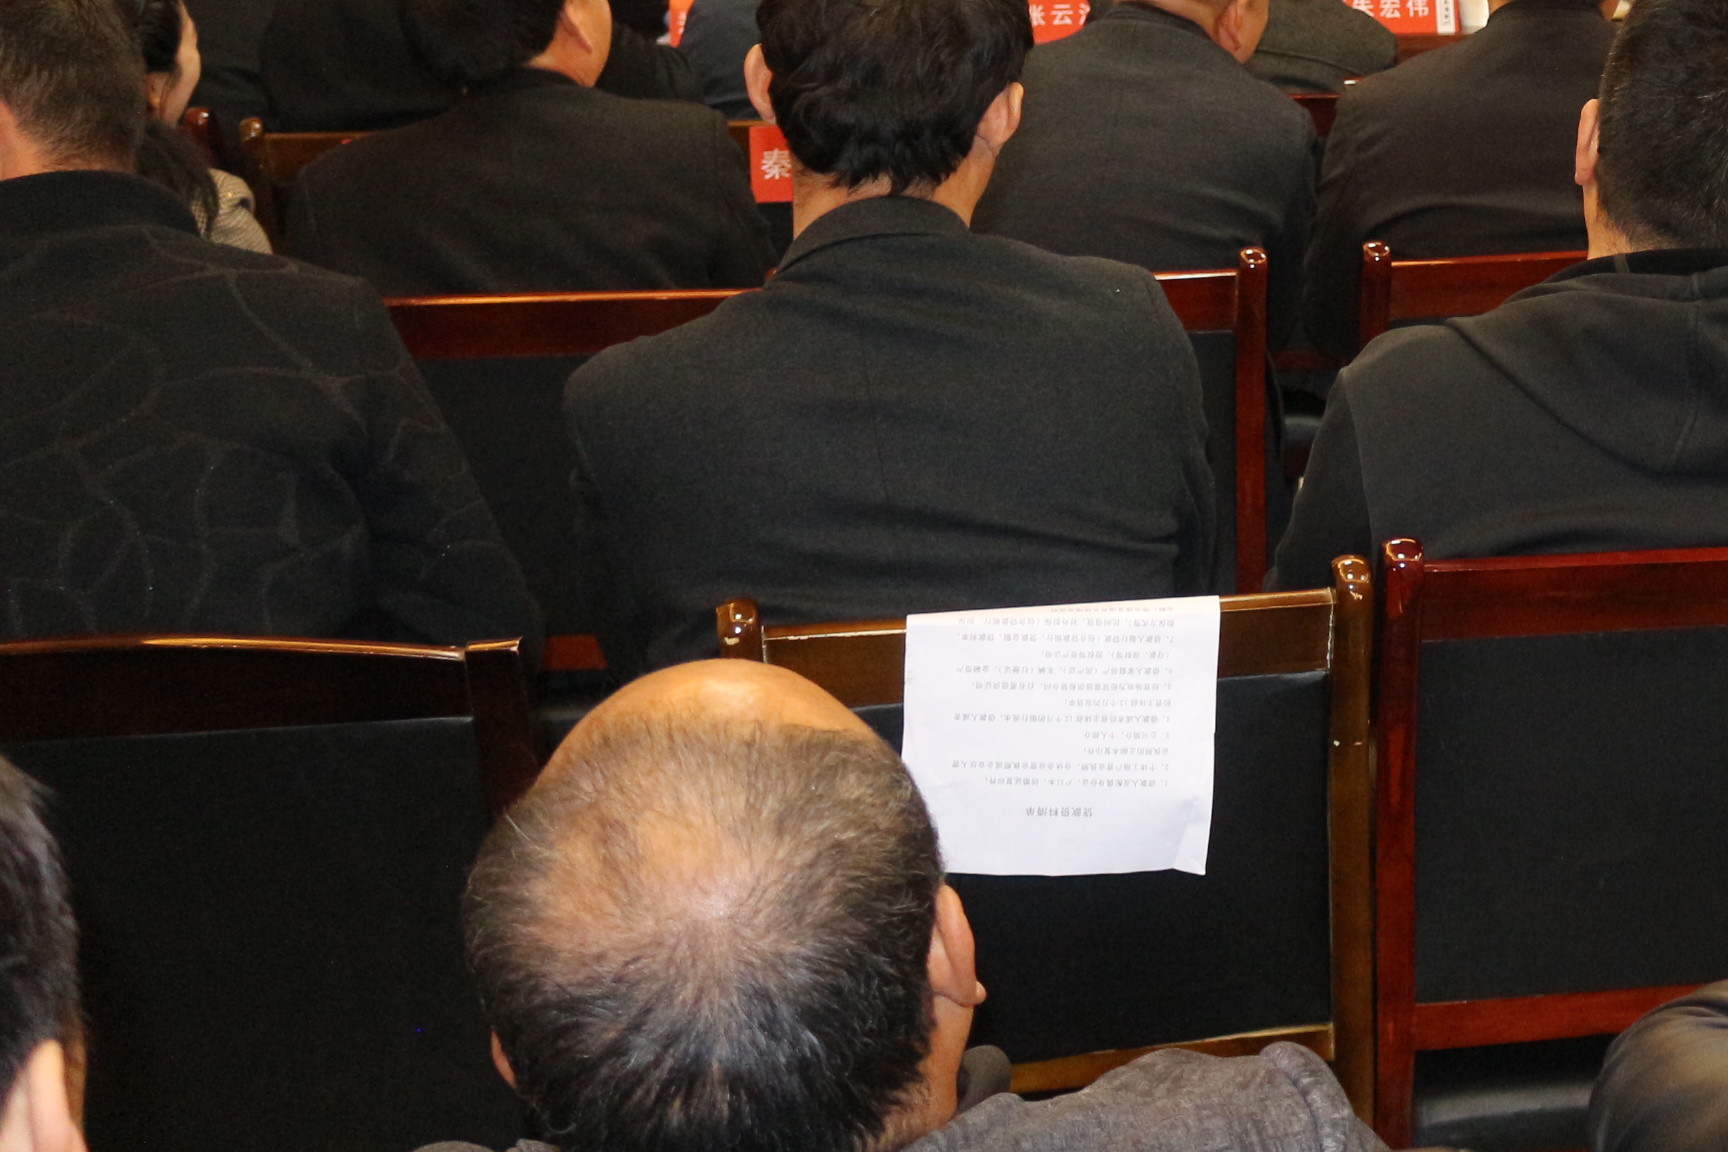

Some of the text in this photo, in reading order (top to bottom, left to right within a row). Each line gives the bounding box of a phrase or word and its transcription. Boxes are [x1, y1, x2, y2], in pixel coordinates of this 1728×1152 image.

[761, 148, 792, 180] 秦
[1025, 805, 1094, 818] 贷款资料清单
